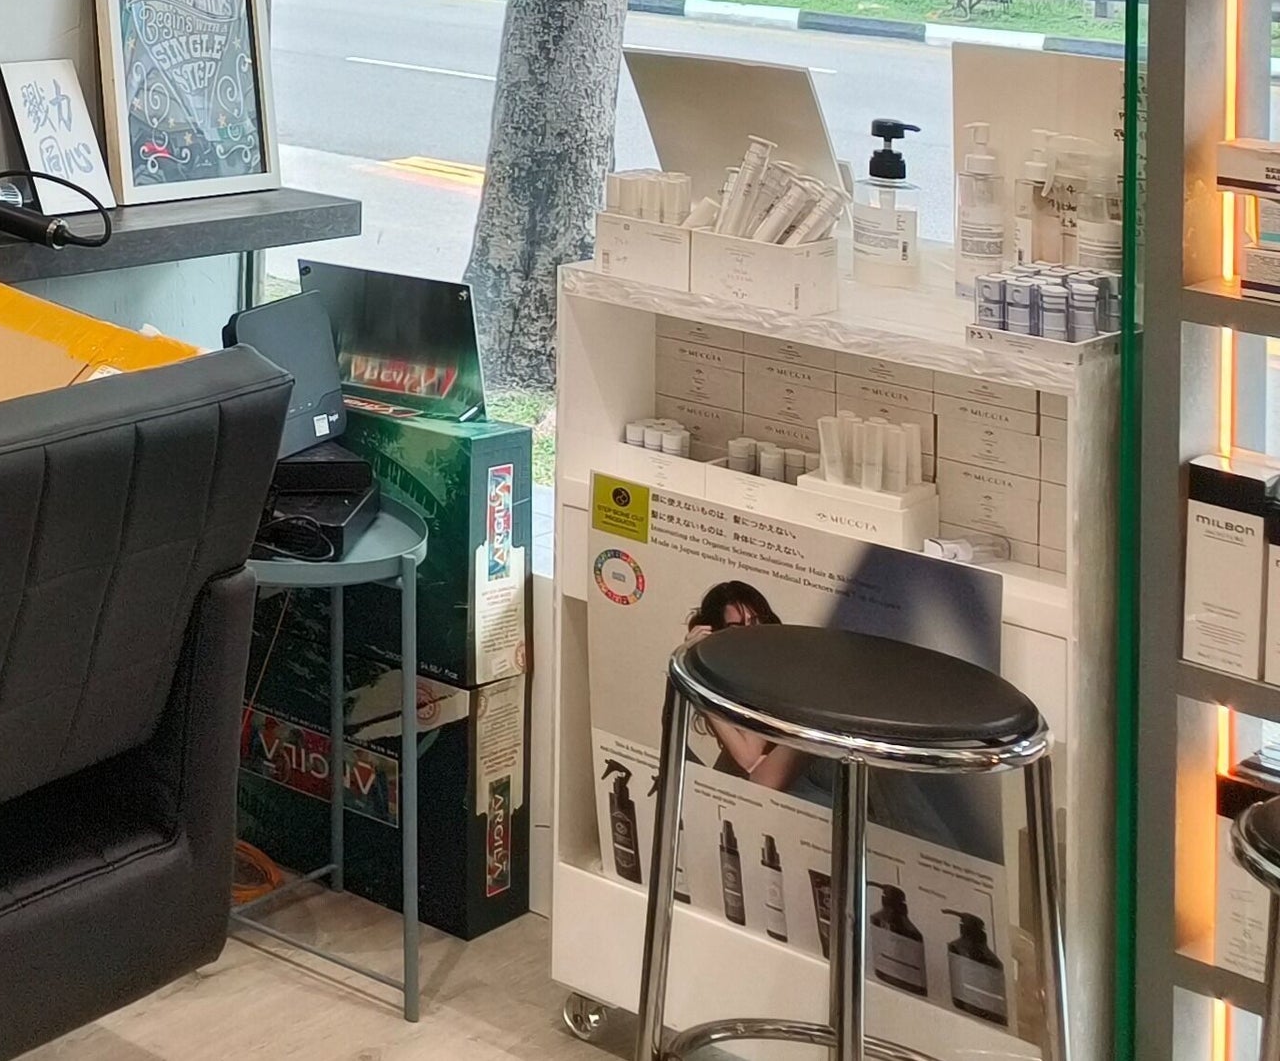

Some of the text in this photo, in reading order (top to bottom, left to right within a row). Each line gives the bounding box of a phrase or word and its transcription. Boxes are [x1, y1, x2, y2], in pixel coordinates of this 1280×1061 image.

[142, 2, 193, 45] Begins
[151, 34, 227, 67] SINGLE
[171, 60, 216, 92] STEP
[650, 536, 670, 548] Made
[679, 543, 700, 557] Japan
[701, 550, 727, 566] quality
[727, 557, 737, 568] by
[738, 560, 770, 576] Japanese
[772, 570, 801, 585] Medical
[803, 578, 834, 594] Doctors
[732, 544, 759, 559] Science
[760, 553, 794, 569] Solutions
[795, 563, 806, 572] for
[808, 566, 826, 577] Hair
[828, 572, 835, 580] &
